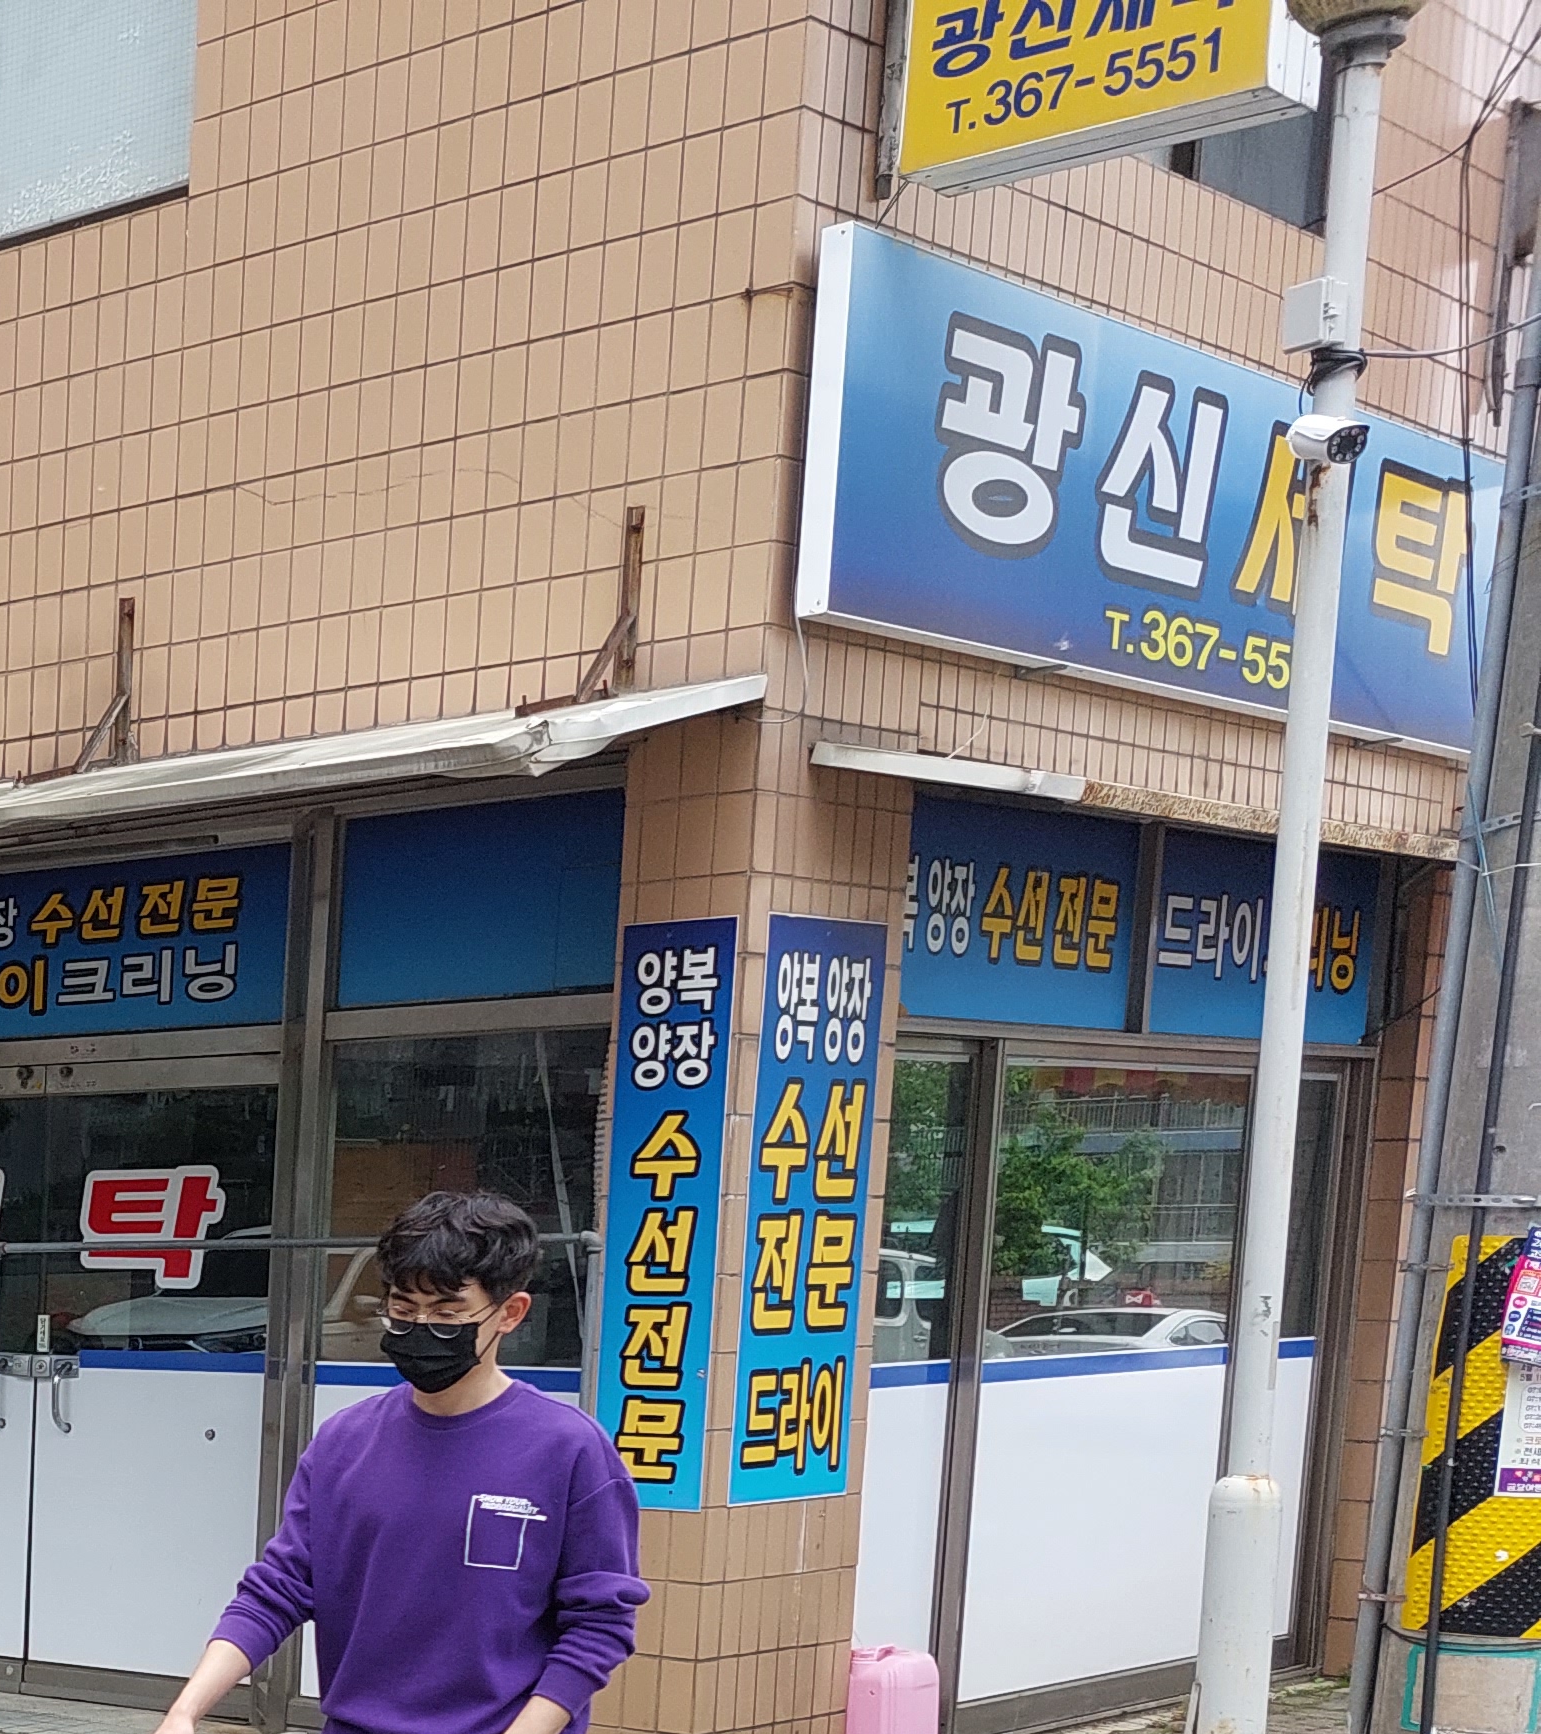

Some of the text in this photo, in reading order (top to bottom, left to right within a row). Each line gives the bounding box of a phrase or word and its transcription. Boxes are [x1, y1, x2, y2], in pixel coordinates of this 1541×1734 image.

[931, 0, 1235, 79] 광신세
[946, 27, 1223, 134] T.367-5551
[1106, 609, 1291, 690] T.367-55
[29, 885, 126, 944] 수선
[139, 876, 240, 935] 전문
[926, 859, 976, 956] 양장
[982, 867, 1049, 962] 수선
[1053, 875, 1120, 968] 전문
[637, 946, 718, 1015] 양복
[775, 951, 872, 1063] 양복 양장
[631, 1021, 716, 1087] 양장
[761, 1081, 865, 1200] 수선
[752, 1215, 857, 1331] 전문
[741, 1359, 845, 1471] 드라이
